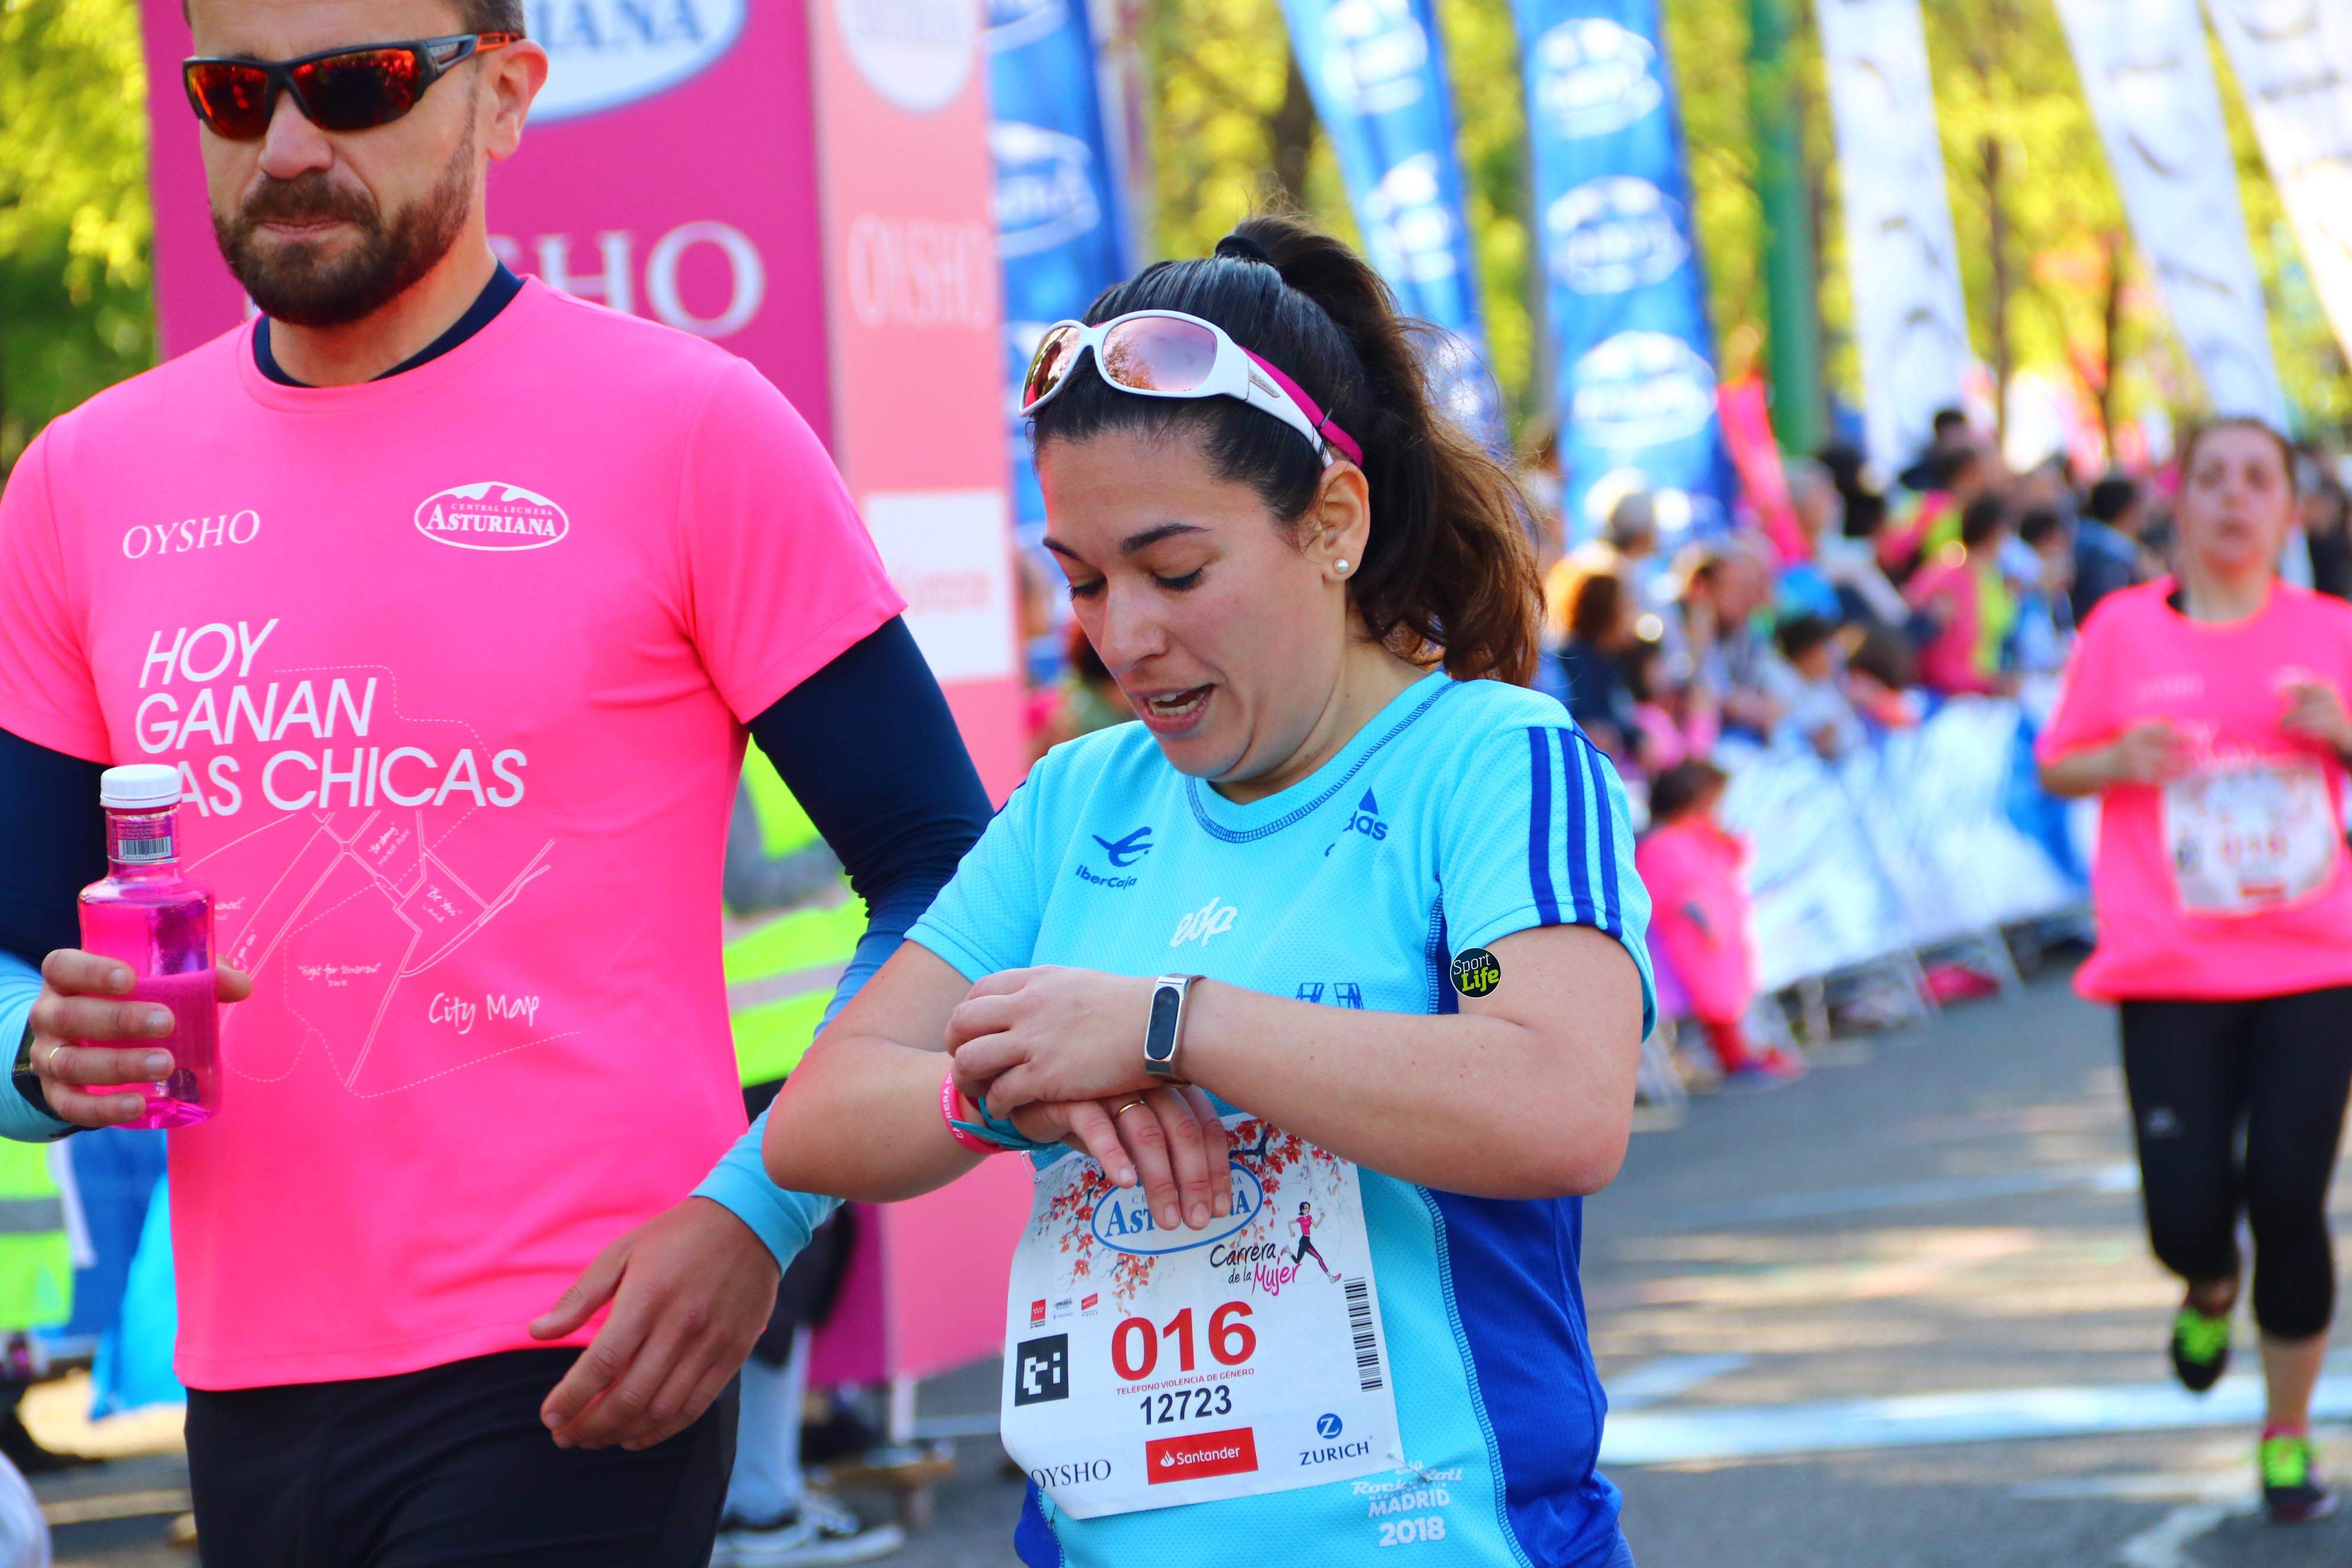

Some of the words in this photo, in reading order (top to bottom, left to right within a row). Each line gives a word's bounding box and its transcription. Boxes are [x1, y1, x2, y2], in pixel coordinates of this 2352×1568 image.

[425, 504, 557, 537] ASTURIANA
[451, 503, 499, 512] CENTRAL
[504, 506, 553, 515] LECHERA
[122, 509, 260, 559] OYSHO
[139, 619, 279, 688] HOY
[135, 678, 377, 754] GANAN
[177, 756, 242, 818] AS
[262, 746, 527, 812] CHICAS
[1170, 896, 1237, 948] edp
[1453, 953, 1491, 975] Sport
[1461, 966, 1500, 992] Life
[429, 992, 476, 1034] City
[486, 994, 539, 1027] Map
[1210, 1243, 1276, 1268] Carrera
[1229, 1268, 1240, 1284] de
[1243, 1266, 1252, 1282] la
[1252, 1256, 1301, 1296] Mujer
[1112, 1301, 1256, 1381] 016
[1116, 1382, 1160, 1395] TELÉFONO
[1161, 1374, 1205, 1389] VIOLENCIA
[1207, 1373, 1219, 1381] DE
[1220, 1367, 1255, 1380] GÉNERO
[1140, 1385, 1232, 1425] 12723
[1177, 1446, 1240, 1465] Santander
[1299, 1441, 1369, 1466] ZURICH
[1031, 1459, 1111, 1489] OYSHO
[1368, 1489, 1451, 1518] MADRID
[1378, 1516, 1446, 1547] 2018
